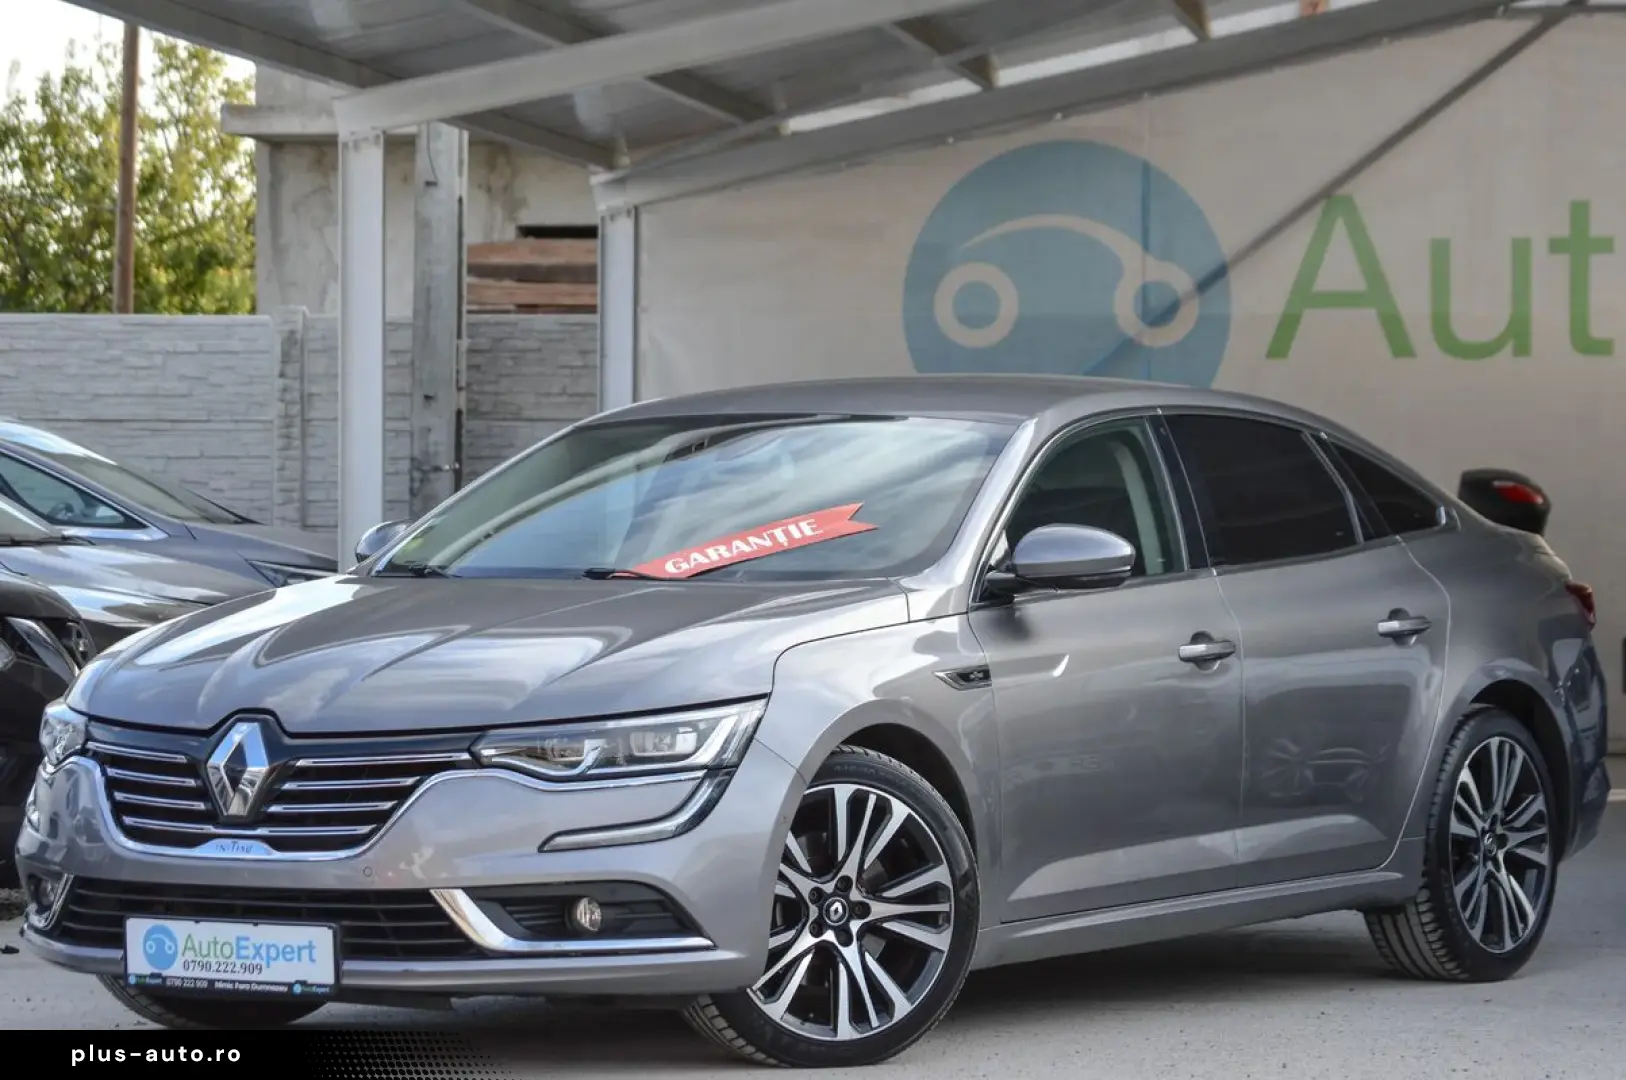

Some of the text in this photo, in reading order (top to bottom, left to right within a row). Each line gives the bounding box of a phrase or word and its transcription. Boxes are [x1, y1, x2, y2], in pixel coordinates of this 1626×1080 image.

[1265, 193, 1615, 361] Aut
[181, 933, 317, 968] AutoExpert
[183, 960, 263, 976] 0790.222.909
